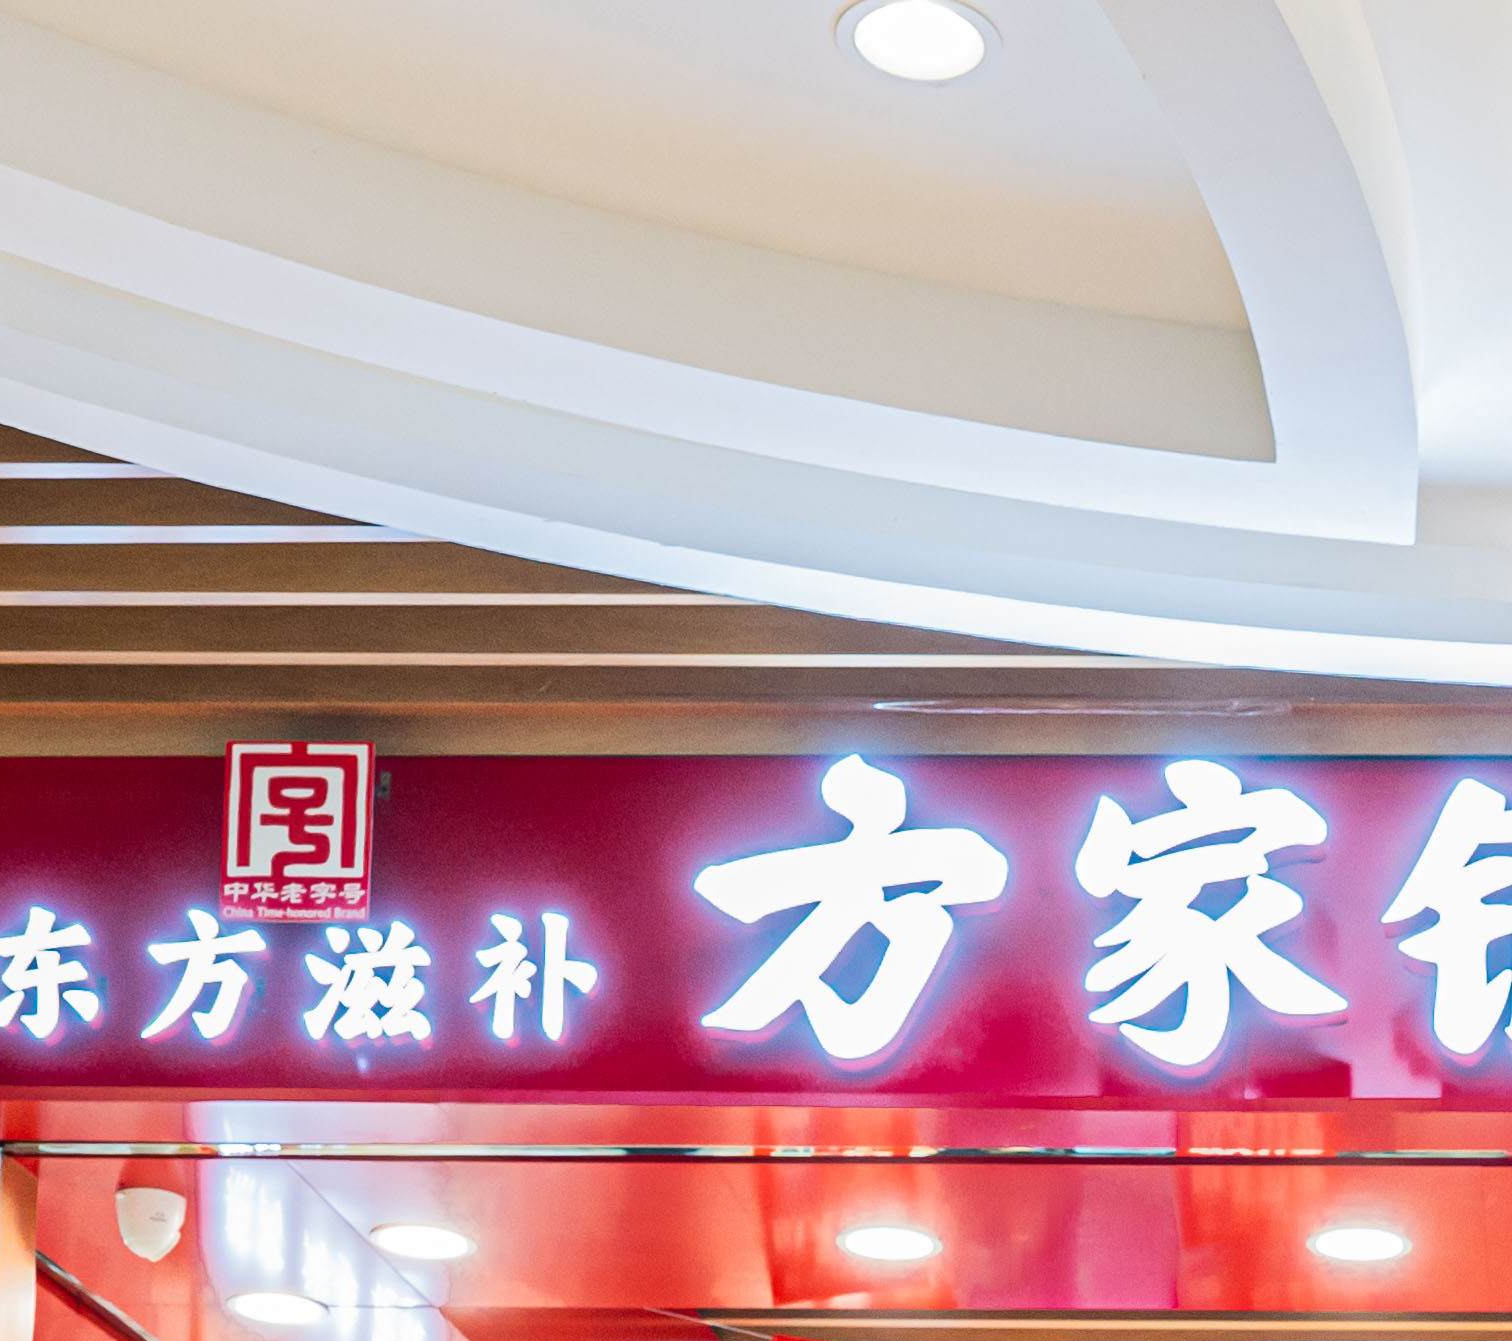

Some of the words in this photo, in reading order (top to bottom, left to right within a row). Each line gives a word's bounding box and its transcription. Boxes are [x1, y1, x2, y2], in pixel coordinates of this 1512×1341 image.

[223, 882, 366, 904] 中华老字号
[223, 906, 254, 918] China
[258, 906, 331, 919] Time-honored
[334, 906, 366, 919] Brand
